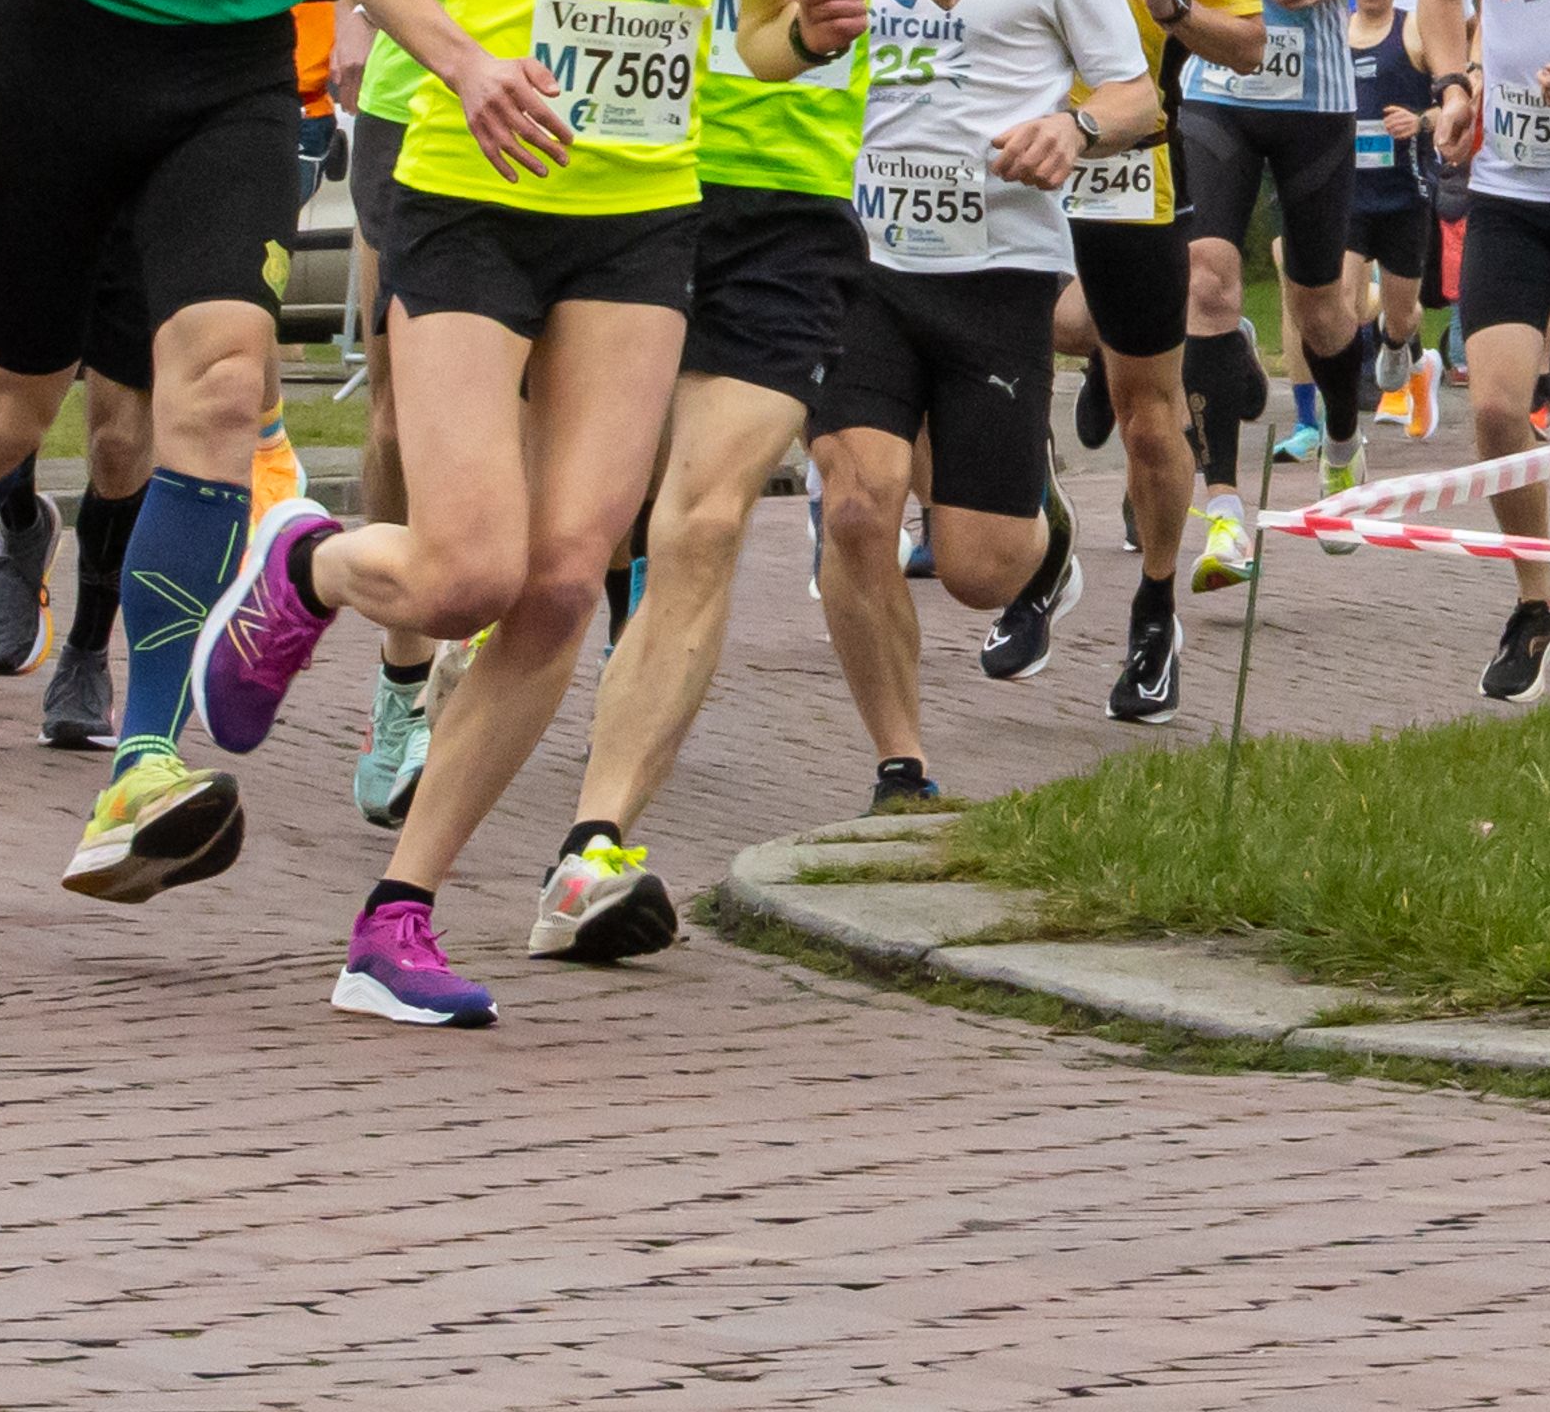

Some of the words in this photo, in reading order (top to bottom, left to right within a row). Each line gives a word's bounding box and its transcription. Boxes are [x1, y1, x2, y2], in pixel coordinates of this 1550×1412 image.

[551, 1, 692, 48] Verhoog's
[535, 42, 692, 101] M7569
[870, 44, 939, 86] 25
[866, 152, 975, 186] Verhoog's
[1071, 164, 1152, 194] 7546
[857, 184, 984, 224] M7555
